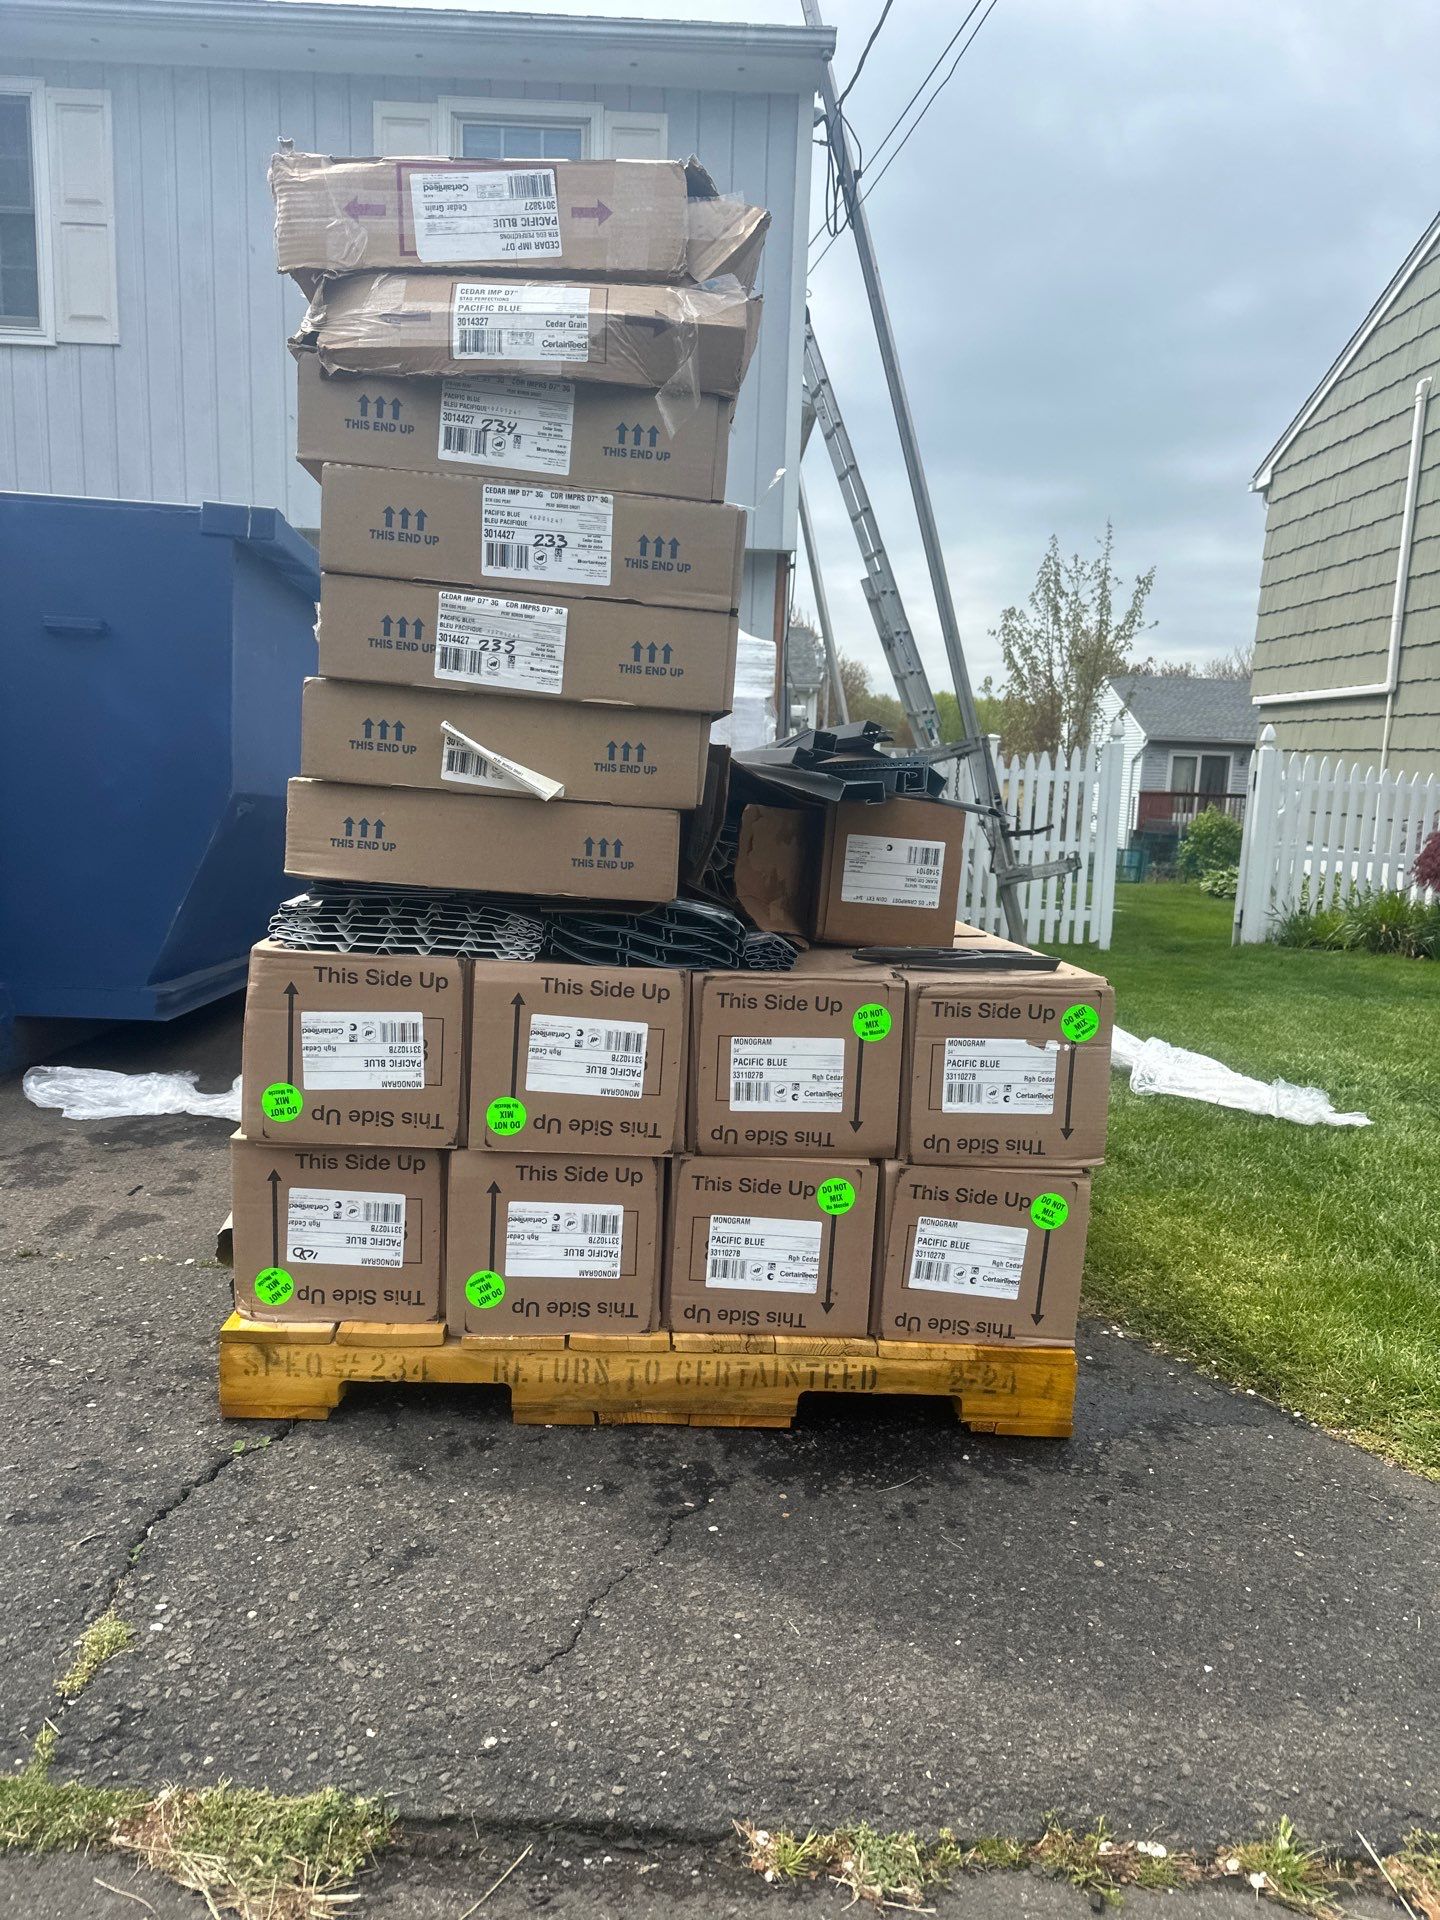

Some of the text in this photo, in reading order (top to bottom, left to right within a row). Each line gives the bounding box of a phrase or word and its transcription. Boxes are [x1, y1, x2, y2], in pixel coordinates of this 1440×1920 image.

[424, 184, 469, 192] CertainTeed
[525, 201, 555, 210] 3013827
[494, 217, 557, 227] PACIFIC BLUE
[518, 242, 532, 250] IMP
[535, 241, 559, 249] CEDAR
[458, 318, 488, 326] 3014327
[546, 320, 566, 328] Cedar
[542, 340, 587, 349] CertainTeed
[444, 392, 480, 402] PACIFIC BLUE
[459, 402, 487, 412] PACIFIQUE
[443, 412, 474, 424] 3014427
[345, 419, 414, 434] THIS END UP
[481, 419, 517, 435] 234
[485, 487, 506, 495] CEDAR
[508, 488, 520, 496] IMP
[565, 493, 585, 501] IMPRS
[484, 509, 505, 517] PACIFIC
[369, 529, 439, 545] THIS END UP
[484, 529, 515, 539] 3014427
[533, 534, 568, 548] 233
[520, 604, 540, 612] IMPRS
[455, 624, 482, 633] PACIFIQUE
[439, 633, 469, 645] 3014427
[619, 664, 684, 677] THIS END UP
[594, 763, 657, 775] THIS END UP
[331, 838, 396, 851] THIS END UP
[314, 966, 448, 992] This Side Up
[541, 977, 670, 1003] This Side Up
[717, 992, 842, 1015] This Side Up
[870, 1009, 883, 1017] NOT
[932, 1002, 1056, 1023] This Side Up
[1064, 1007, 1088, 1025] DO NOT
[865, 1020, 879, 1028] MIX
[1074, 1019, 1088, 1031] MIX
[364, 1059, 422, 1067] PACIFIC BLUE
[733, 1058, 764, 1066] PACIFIC
[947, 1059, 1000, 1068] PACIFIC BLUE
[586, 1065, 642, 1077] PACIFIC BLUE
[601, 1088, 639, 1097] MONOGRAM
[275, 1096, 289, 1105] MIX
[271, 1108, 285, 1117] NOT
[510, 1121, 520, 1129] DO
[295, 1153, 425, 1174] This Side Up
[516, 1165, 643, 1186] This Side Up
[692, 1175, 816, 1199] This Side Up
[909, 1184, 1031, 1211] This Side Up
[713, 1216, 751, 1225] MONOGRAM
[921, 1218, 958, 1228] MONOGRAM
[711, 1236, 765, 1246] PACIFIC BLUE
[917, 1237, 970, 1250] PACIFIC BLUE
[588, 1249, 619, 1258] PACIFIC
[494, 1357, 877, 1390] RETURN TO CERTAINTEED
